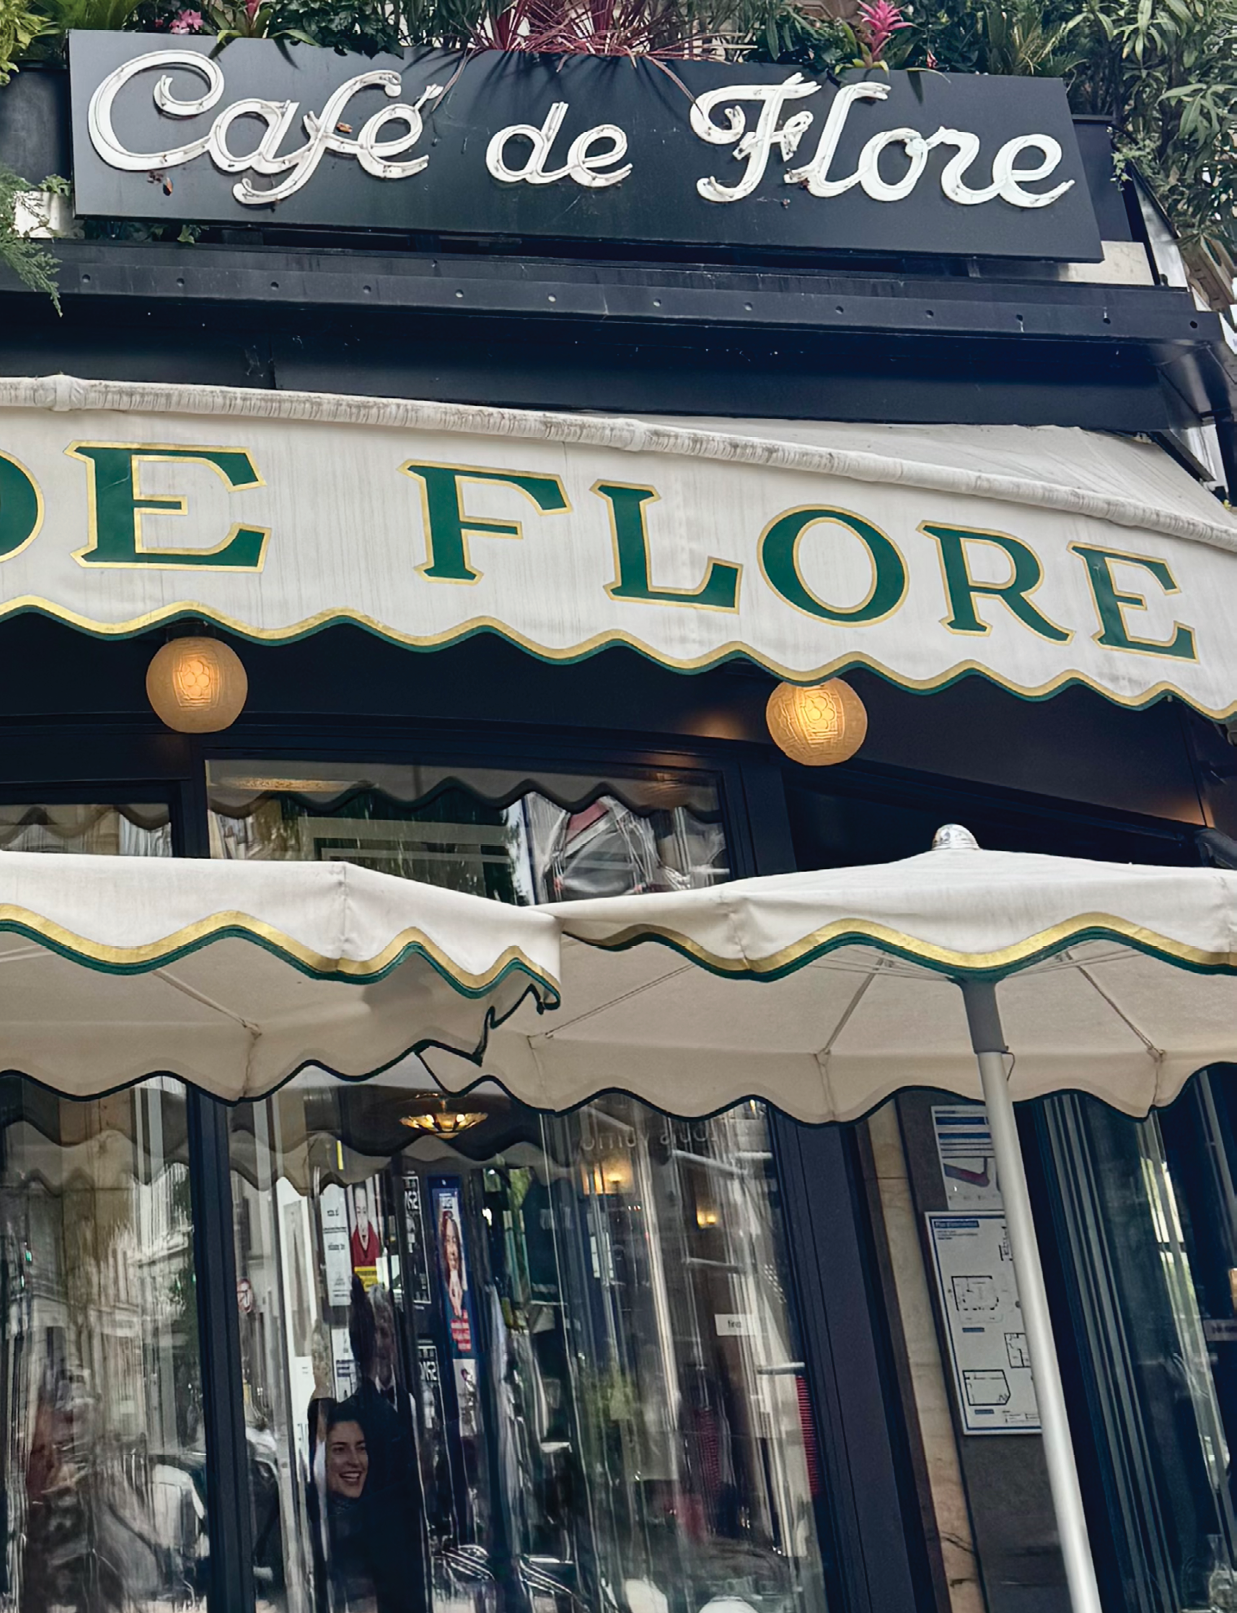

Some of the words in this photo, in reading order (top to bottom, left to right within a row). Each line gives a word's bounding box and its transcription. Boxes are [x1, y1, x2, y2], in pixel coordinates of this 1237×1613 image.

[87, 48, 443, 205] Café
[487, 102, 632, 188] de
[689, 72, 1075, 208] Flore
[399, 459, 1199, 663] FLORE
